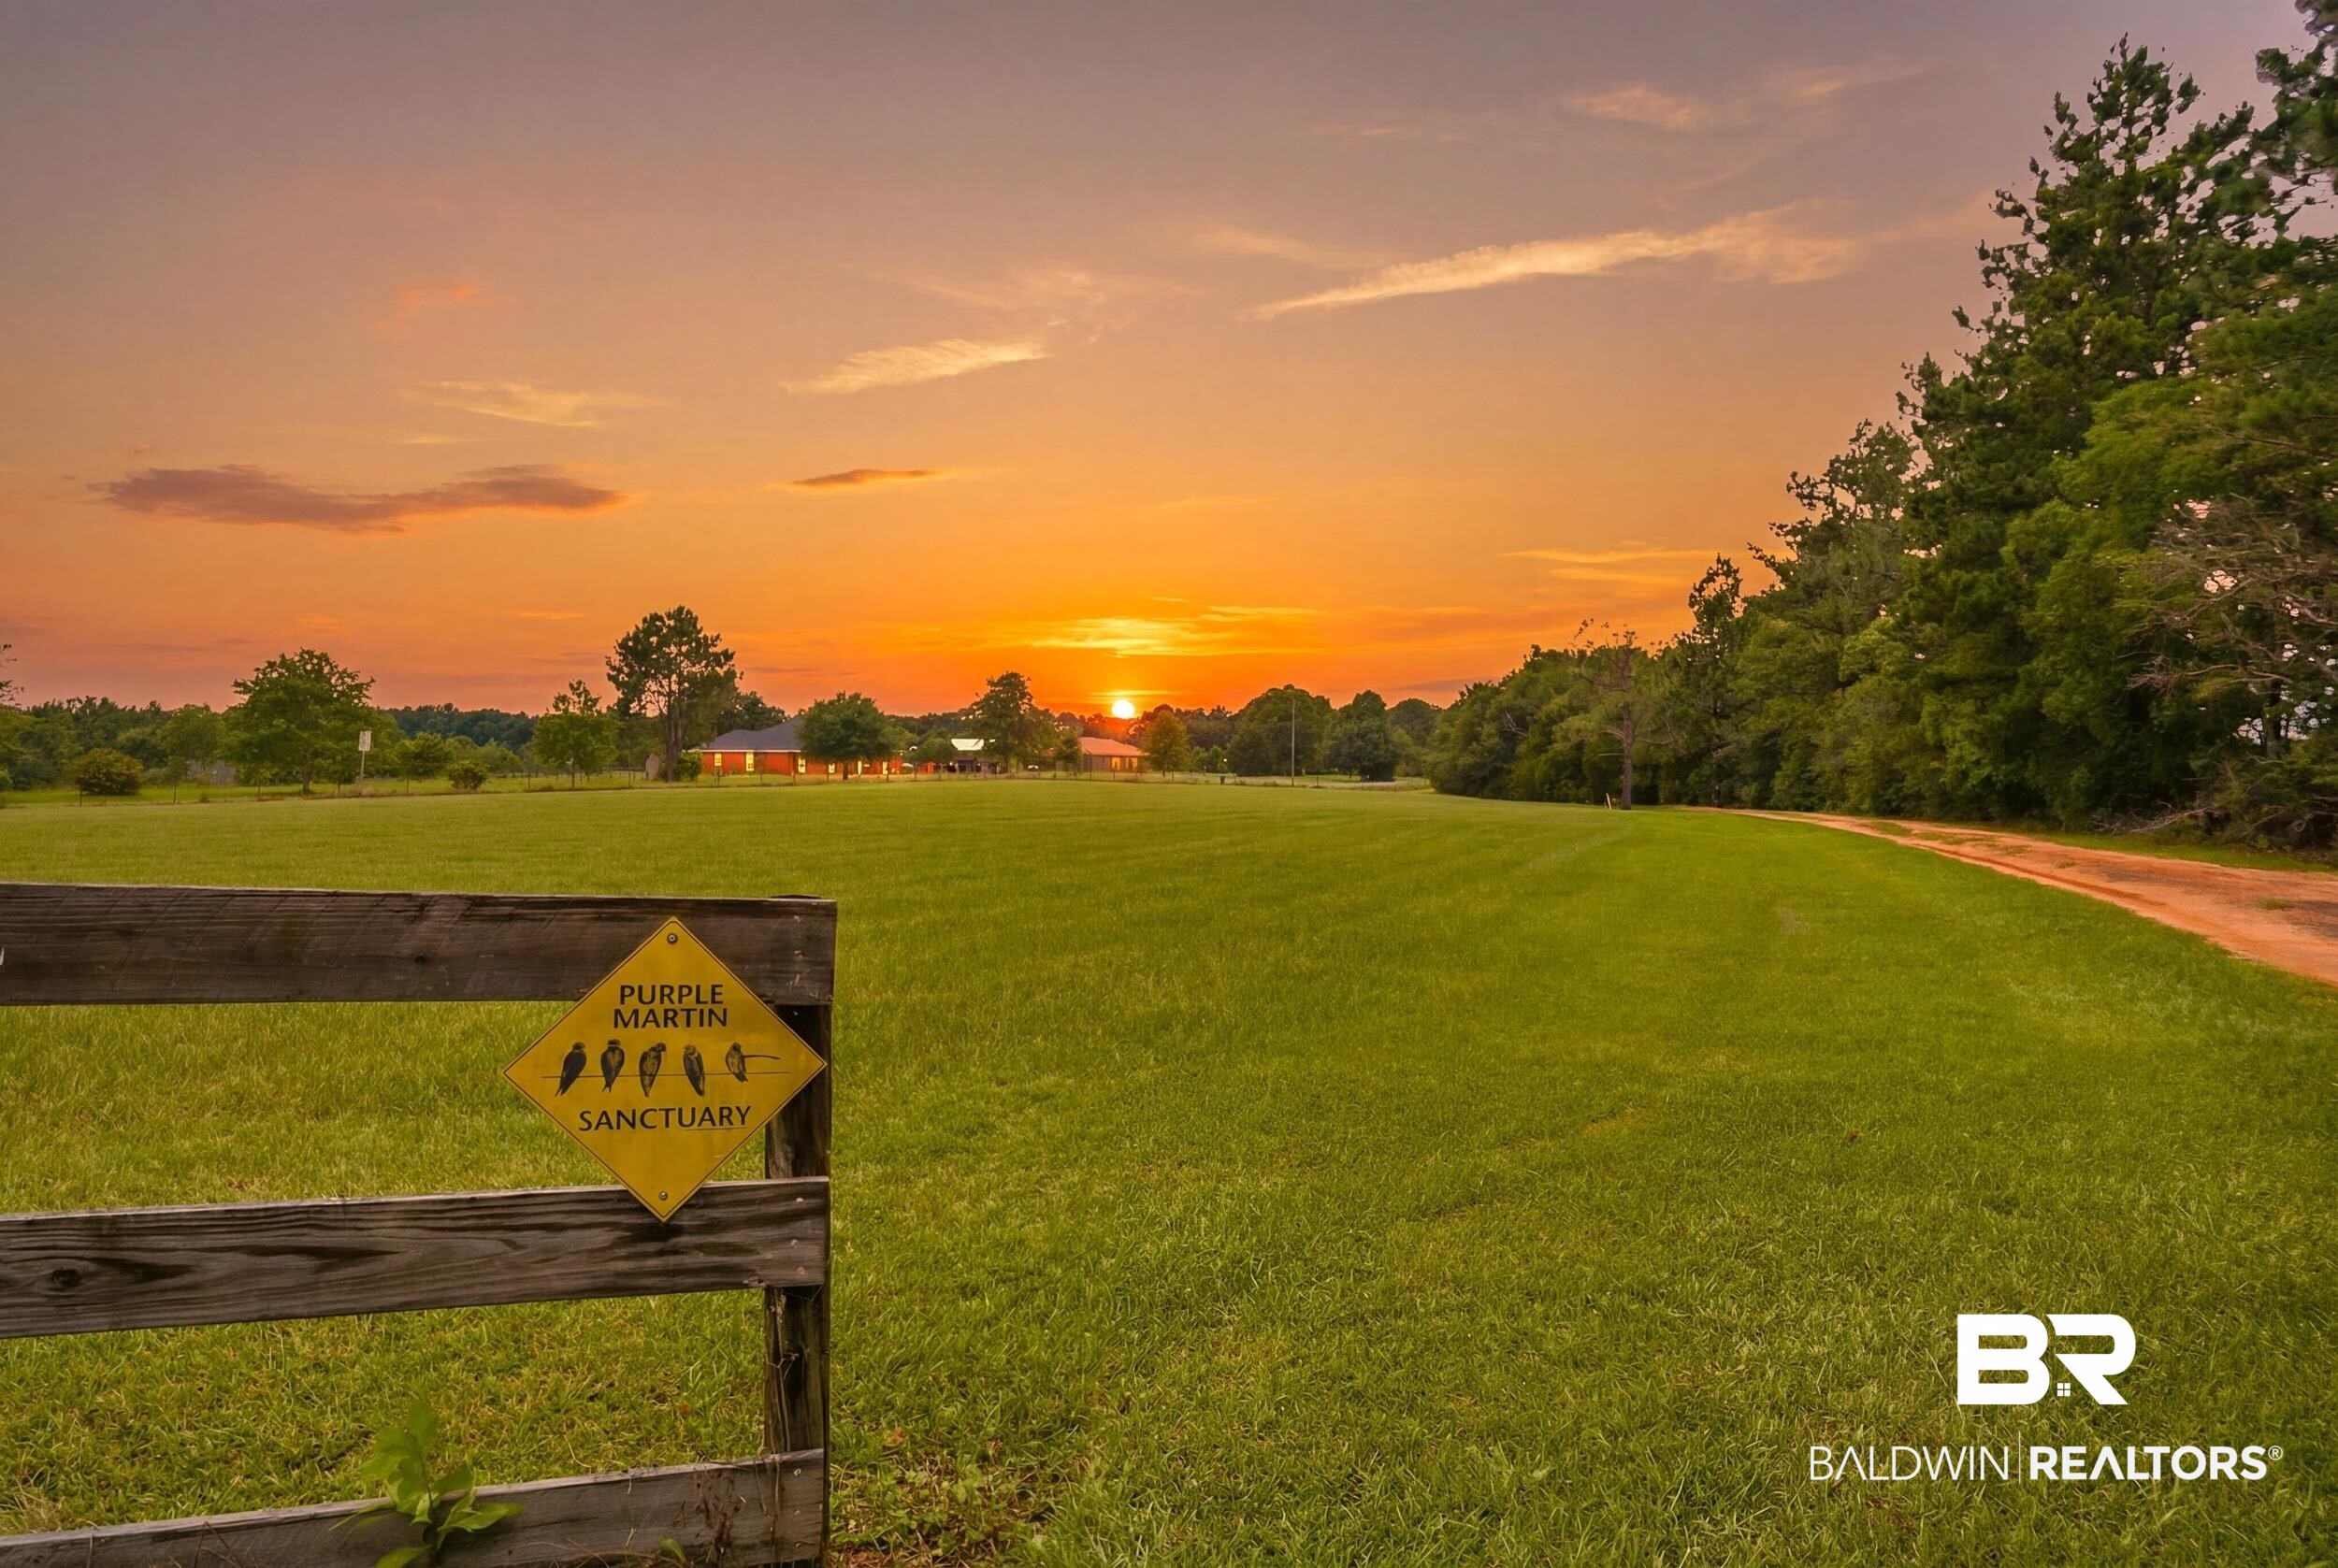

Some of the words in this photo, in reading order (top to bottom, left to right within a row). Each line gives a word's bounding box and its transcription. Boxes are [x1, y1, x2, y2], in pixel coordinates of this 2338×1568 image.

[619, 985, 724, 1005] PURPLE
[613, 1008, 728, 1029] MARTIN
[579, 1106, 752, 1131] SANCTUARY
